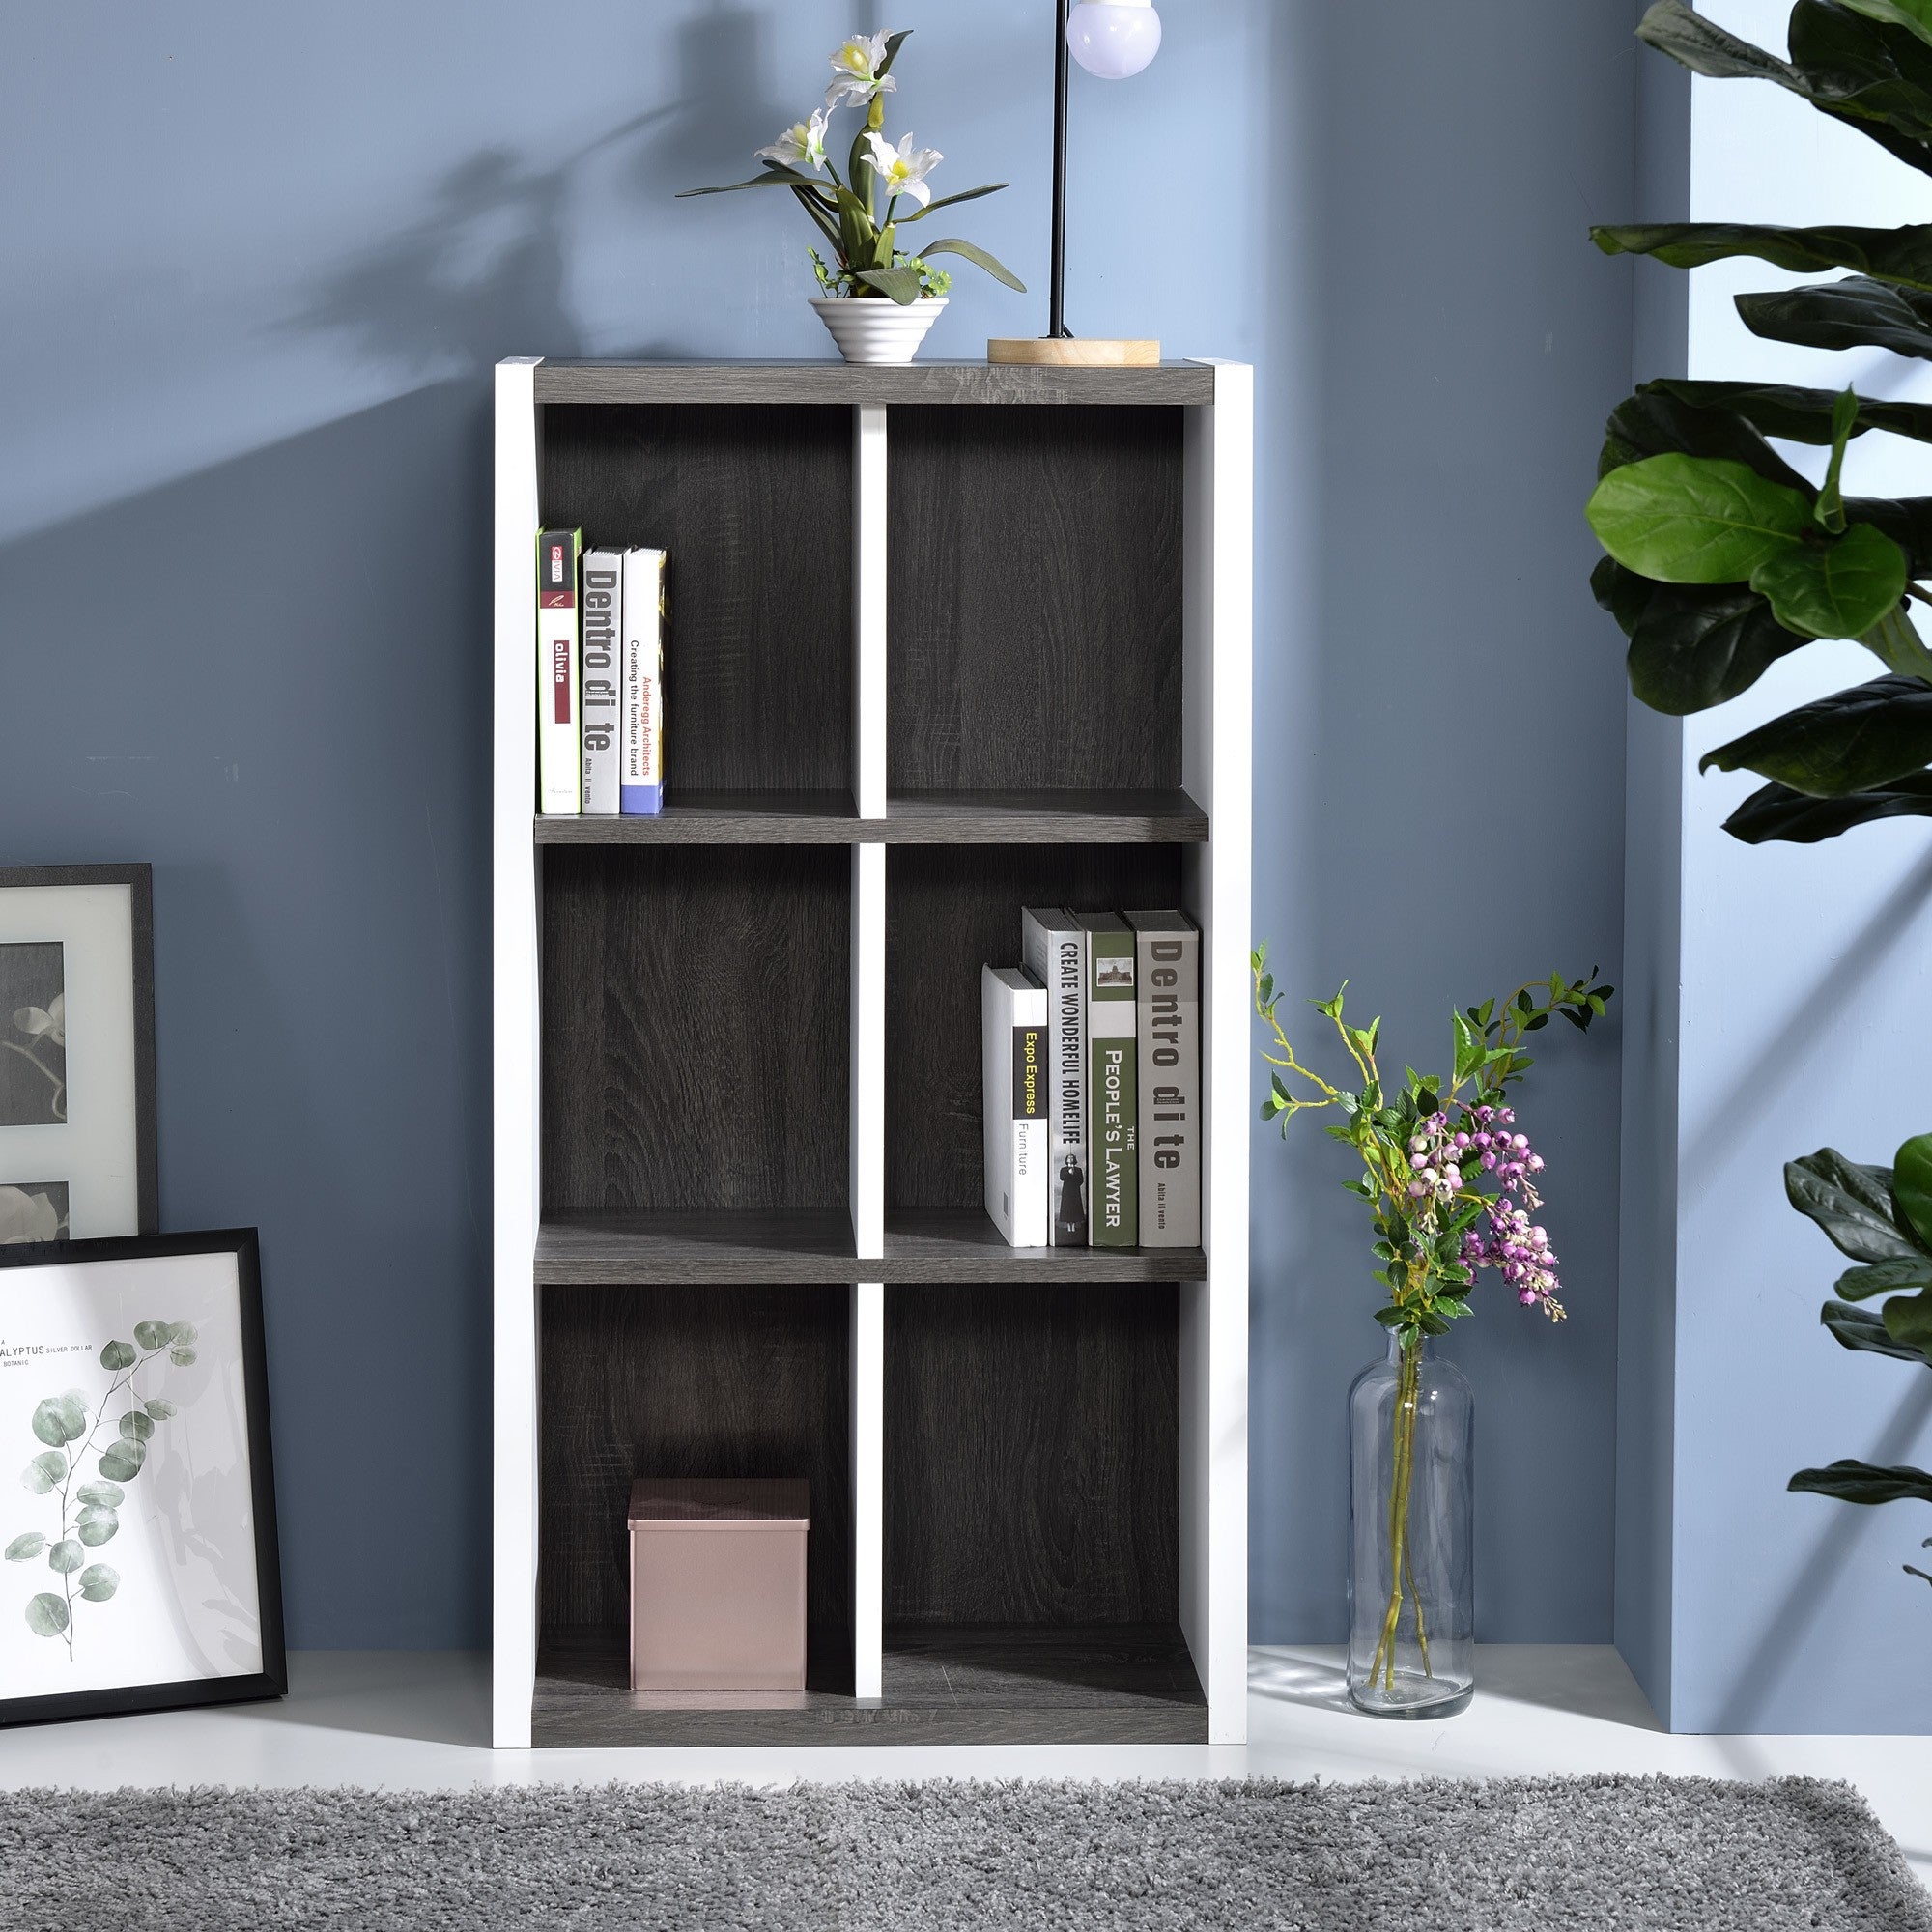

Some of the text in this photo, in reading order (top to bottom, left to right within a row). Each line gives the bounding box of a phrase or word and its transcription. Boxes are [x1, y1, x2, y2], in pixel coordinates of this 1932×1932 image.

[585, 570, 617, 668] Dentro
[555, 642, 568, 683] olivia
[585, 680, 616, 707] di
[629, 639, 639, 776] Creating the furniture brand
[584, 723, 614, 751] te
[641, 677, 651, 776] Anderegg Architects
[1151, 941, 1183, 1067] Dentro
[1060, 942, 1080, 1144] CREATE WONDERFUL HOMELIFE
[1024, 1032, 1037, 1114] Expo Express
[1018, 1123, 1029, 1176] Furniture
[1126, 1125, 1135, 1151] THE
[1154, 1134, 1185, 1169] te
[1105, 1147, 1122, 1227] LAWYER
[1157, 1182, 1167, 1202] Abita
[1157, 1209, 1167, 1230] vento
[0, 1345, 44, 1357] ALYPTUS
